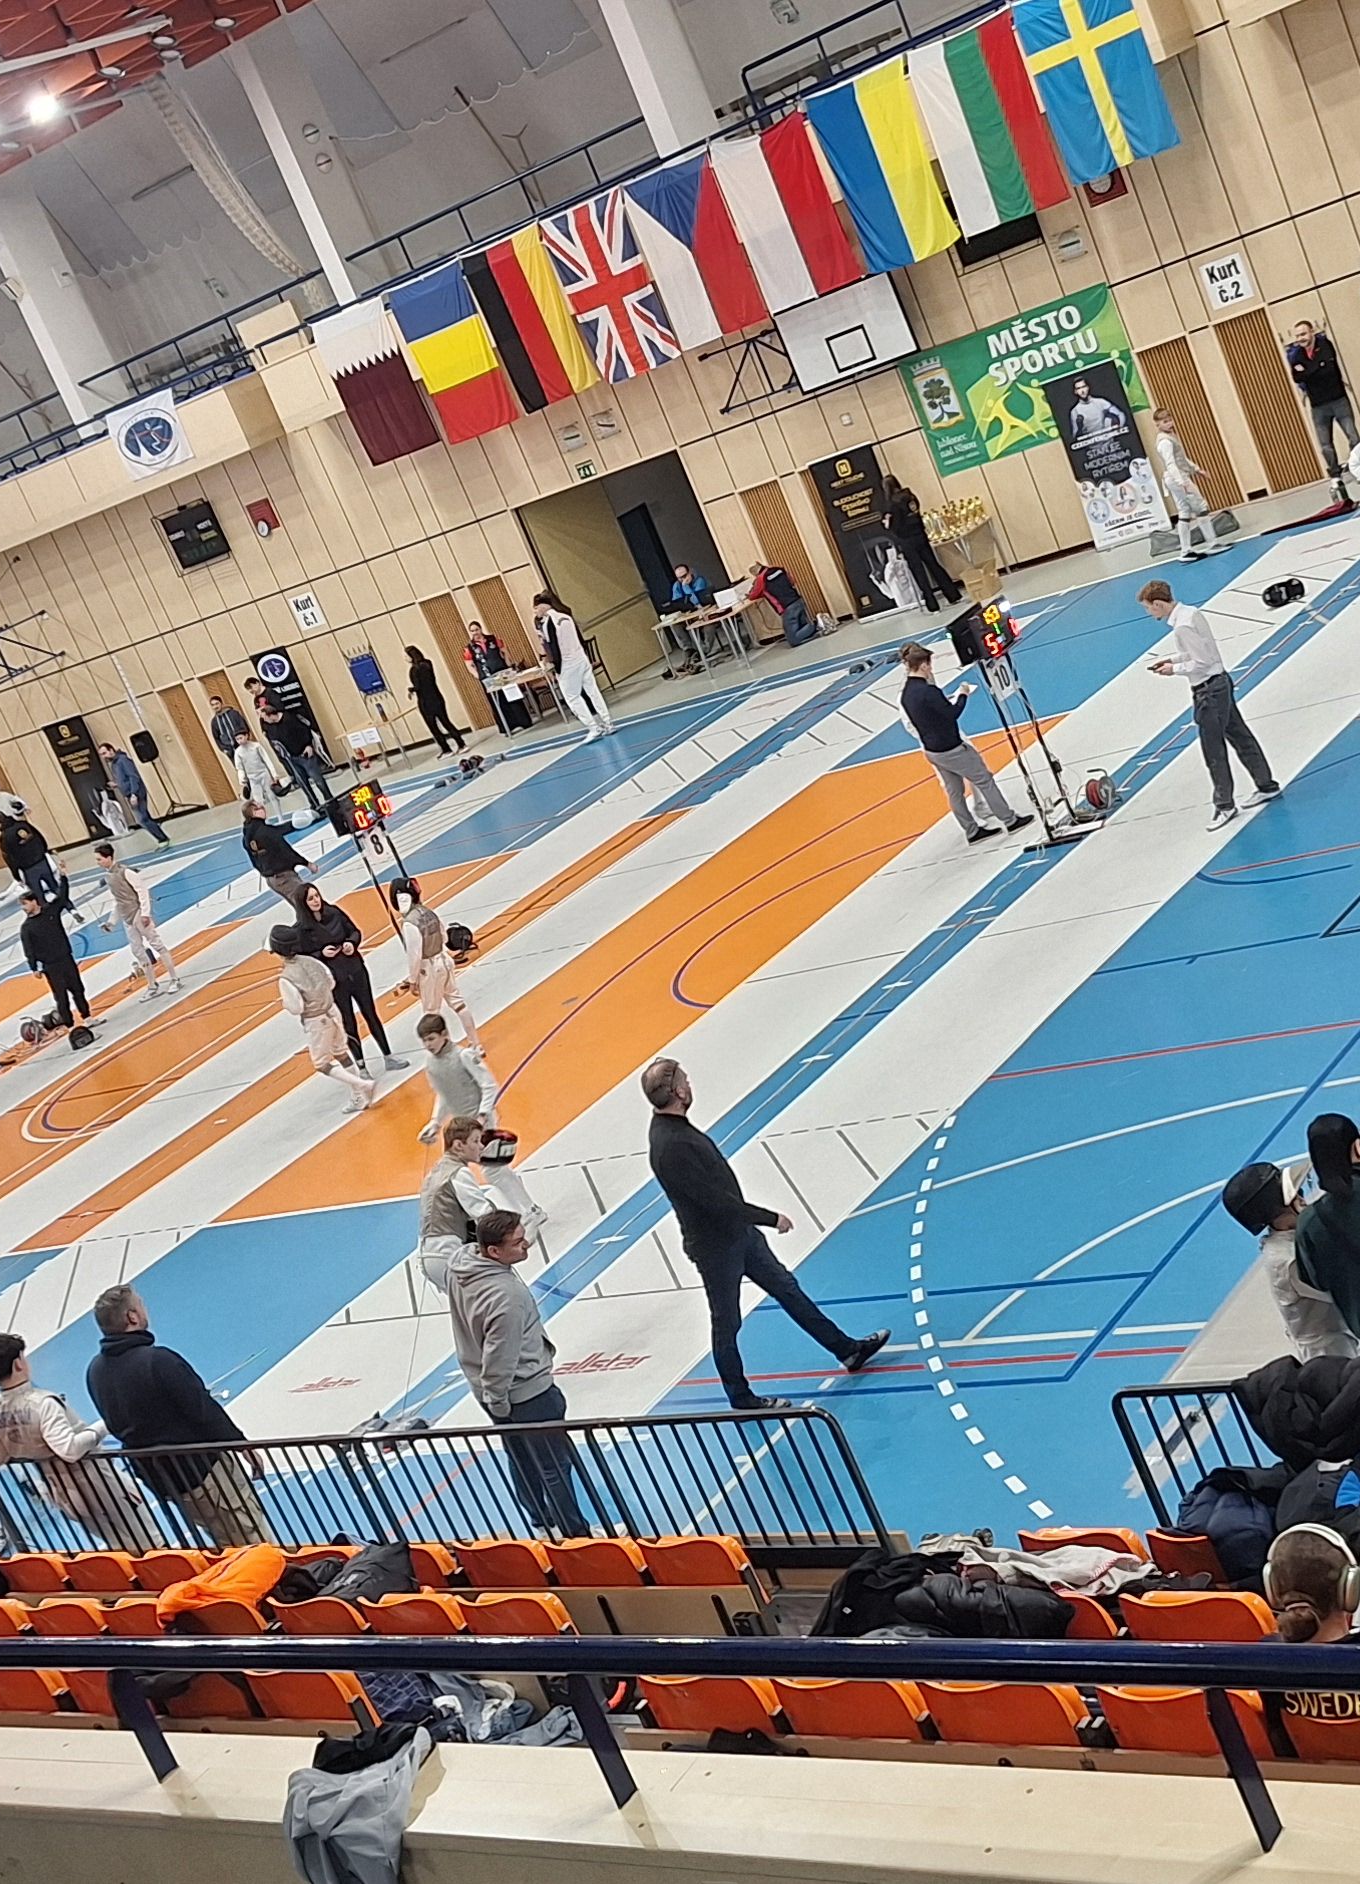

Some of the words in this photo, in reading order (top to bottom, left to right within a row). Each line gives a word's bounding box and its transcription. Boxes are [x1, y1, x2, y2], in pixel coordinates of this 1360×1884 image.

[1205, 258, 1241, 284] Kurt
[1217, 281, 1244, 303] č.2
[987, 305, 1081, 358] MĚSTO
[988, 328, 1098, 387] SPORTU
[293, 595, 314, 612] Kurt
[984, 632, 999, 656] 5
[994, 664, 1010, 691] 10
[354, 810, 368, 828] 0
[377, 796, 391, 814] 0
[370, 834, 384, 855] 8
[552, 1352, 652, 1374] allstar
